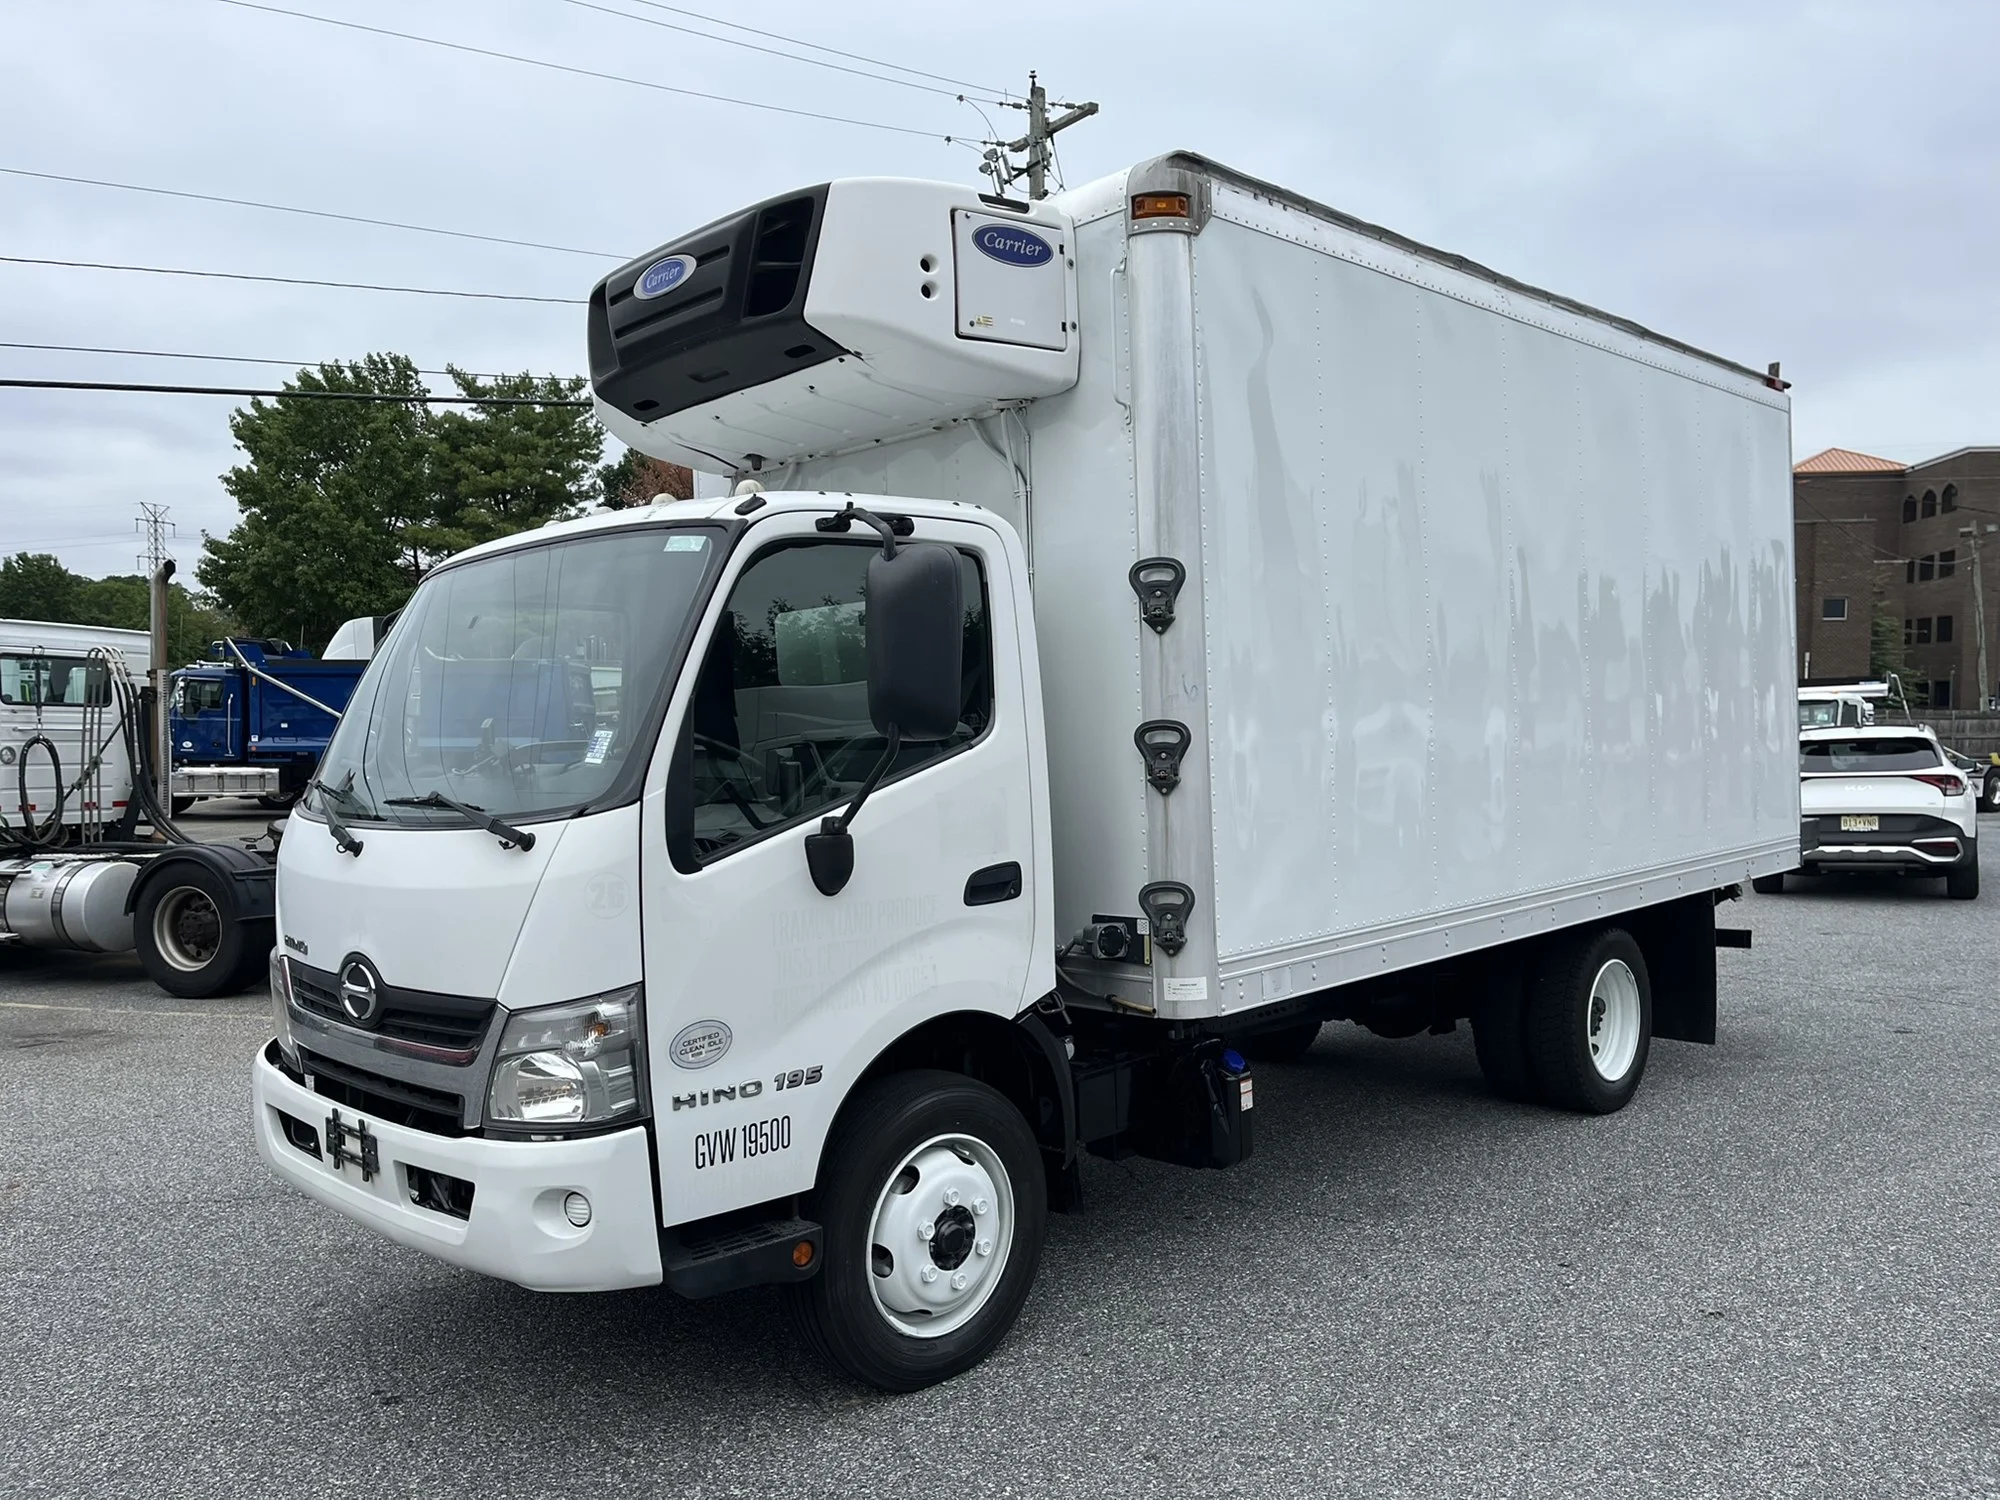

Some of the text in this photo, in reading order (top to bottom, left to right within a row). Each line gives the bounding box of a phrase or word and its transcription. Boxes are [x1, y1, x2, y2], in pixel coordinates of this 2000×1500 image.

[983, 231, 1043, 256] Carrier
[646, 266, 680, 289] Carrier
[589, 880, 625, 909] 26
[680, 1044, 705, 1056] CLEAN
[708, 1038, 724, 1047] IDLE
[682, 1032, 719, 1047] CERTIFIED
[672, 1065, 823, 1111] HINO 195
[695, 1115, 791, 1170] GVW 19500
